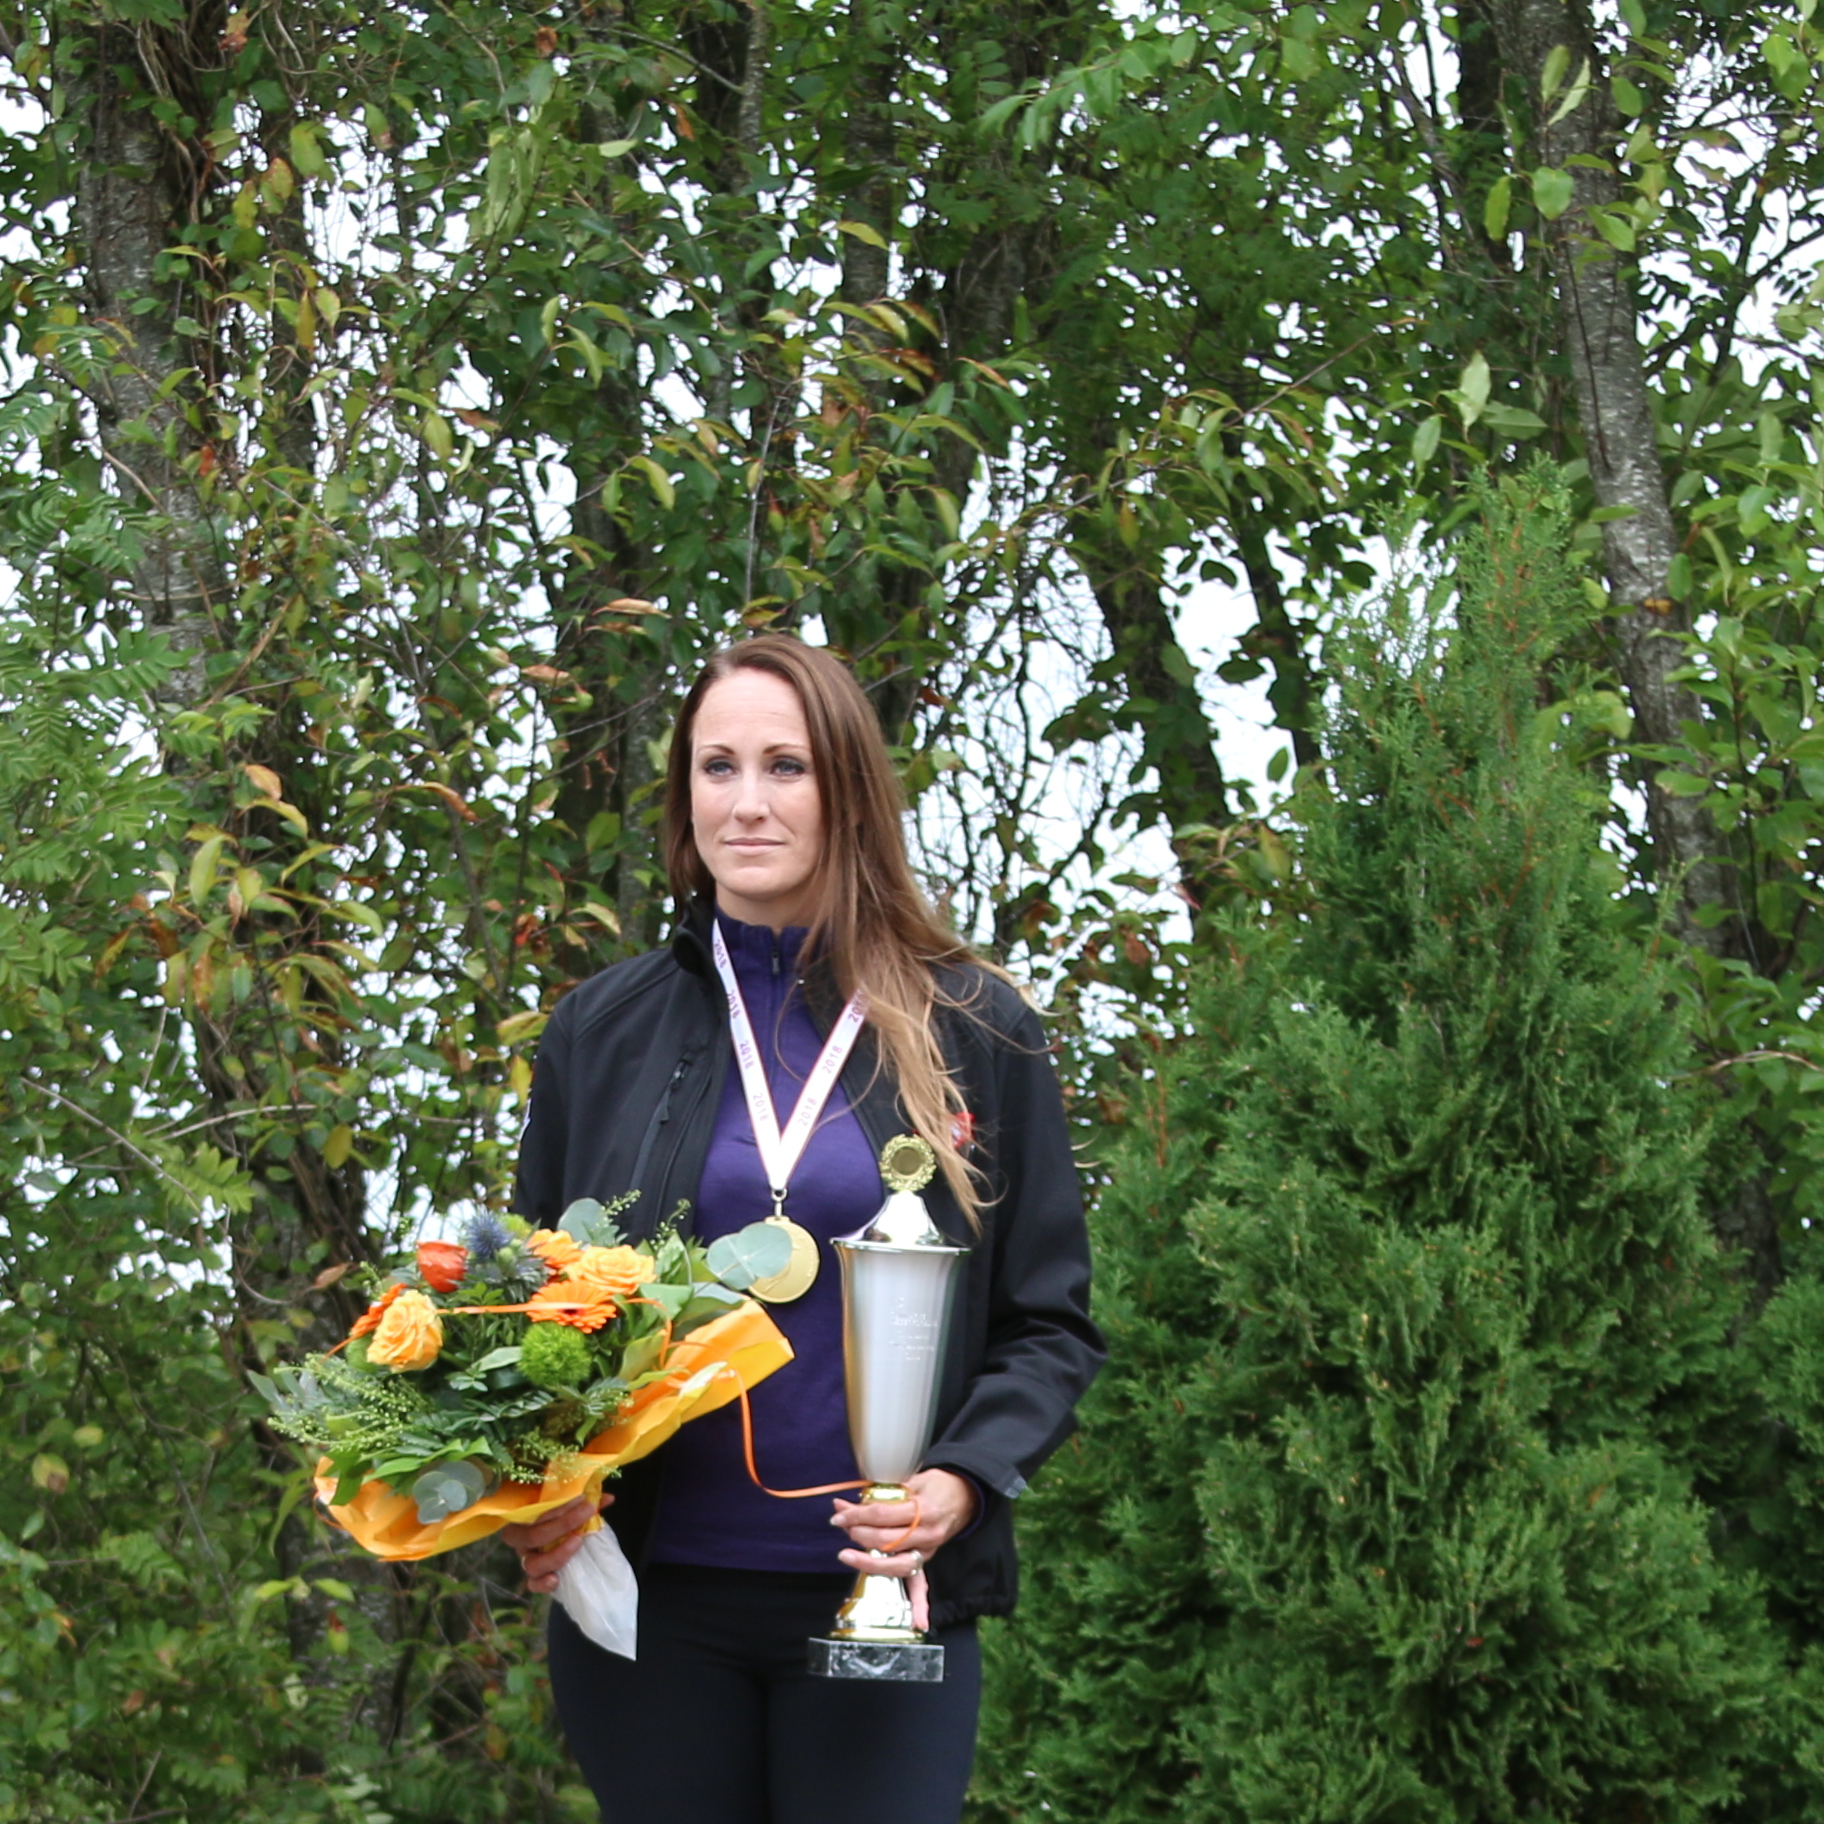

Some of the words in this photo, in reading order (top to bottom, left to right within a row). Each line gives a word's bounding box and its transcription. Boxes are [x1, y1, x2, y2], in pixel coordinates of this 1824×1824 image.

[714, 939, 728, 969] 2018
[727, 989, 741, 1019] 2018
[739, 1040, 755, 1069] 2018
[752, 1092, 769, 1121] 2018
[797, 1097, 817, 1126] 2018
[822, 1045, 842, 1074] 2018
